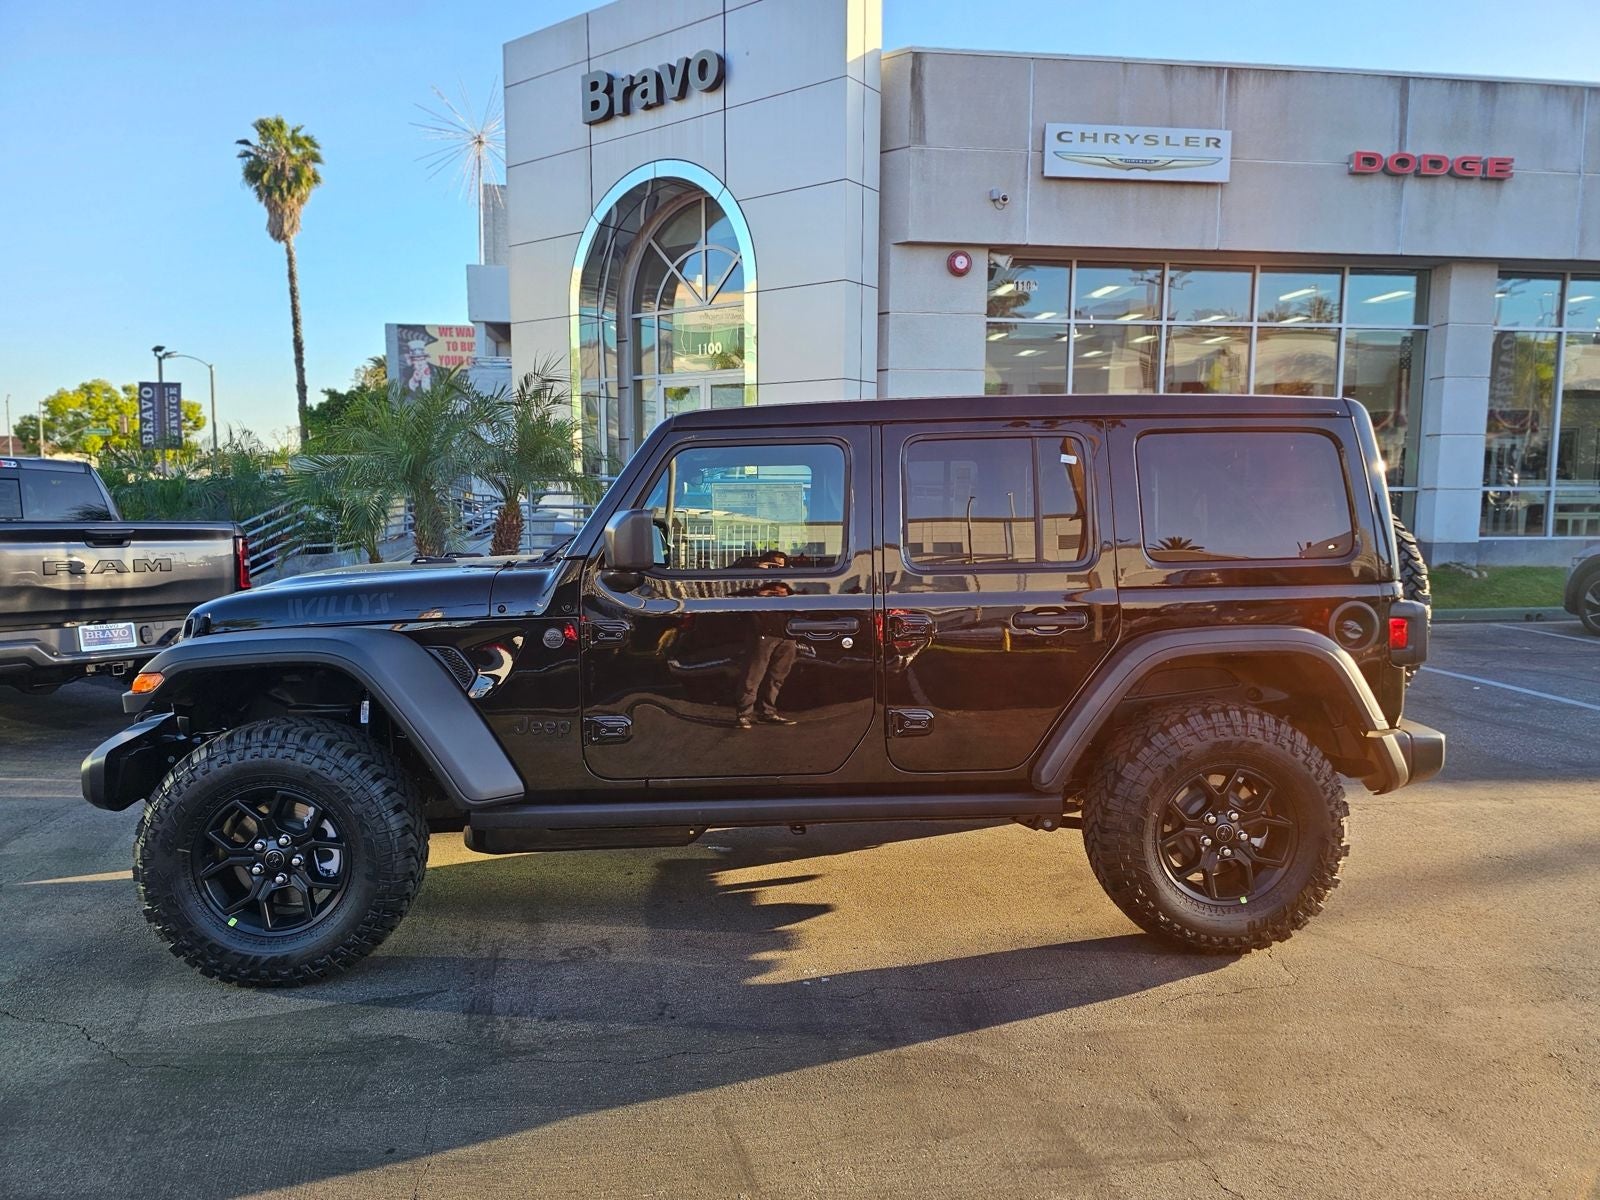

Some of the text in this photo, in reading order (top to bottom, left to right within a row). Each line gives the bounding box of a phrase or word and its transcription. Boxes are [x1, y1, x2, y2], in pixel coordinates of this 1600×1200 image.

[581, 49, 725, 125] Bravo
[1056, 131, 1222, 149] CHRYSLER
[1348, 151, 1514, 180] DODGE
[438, 326, 453, 337] WE
[446, 341, 458, 352] TO
[698, 342, 722, 356] 1100
[141, 387, 154, 445] BRAVO
[42, 558, 173, 576] RAM
[288, 593, 391, 619] WILLYS
[84, 629, 129, 640] BRAVO
[512, 716, 571, 738] Jeep
